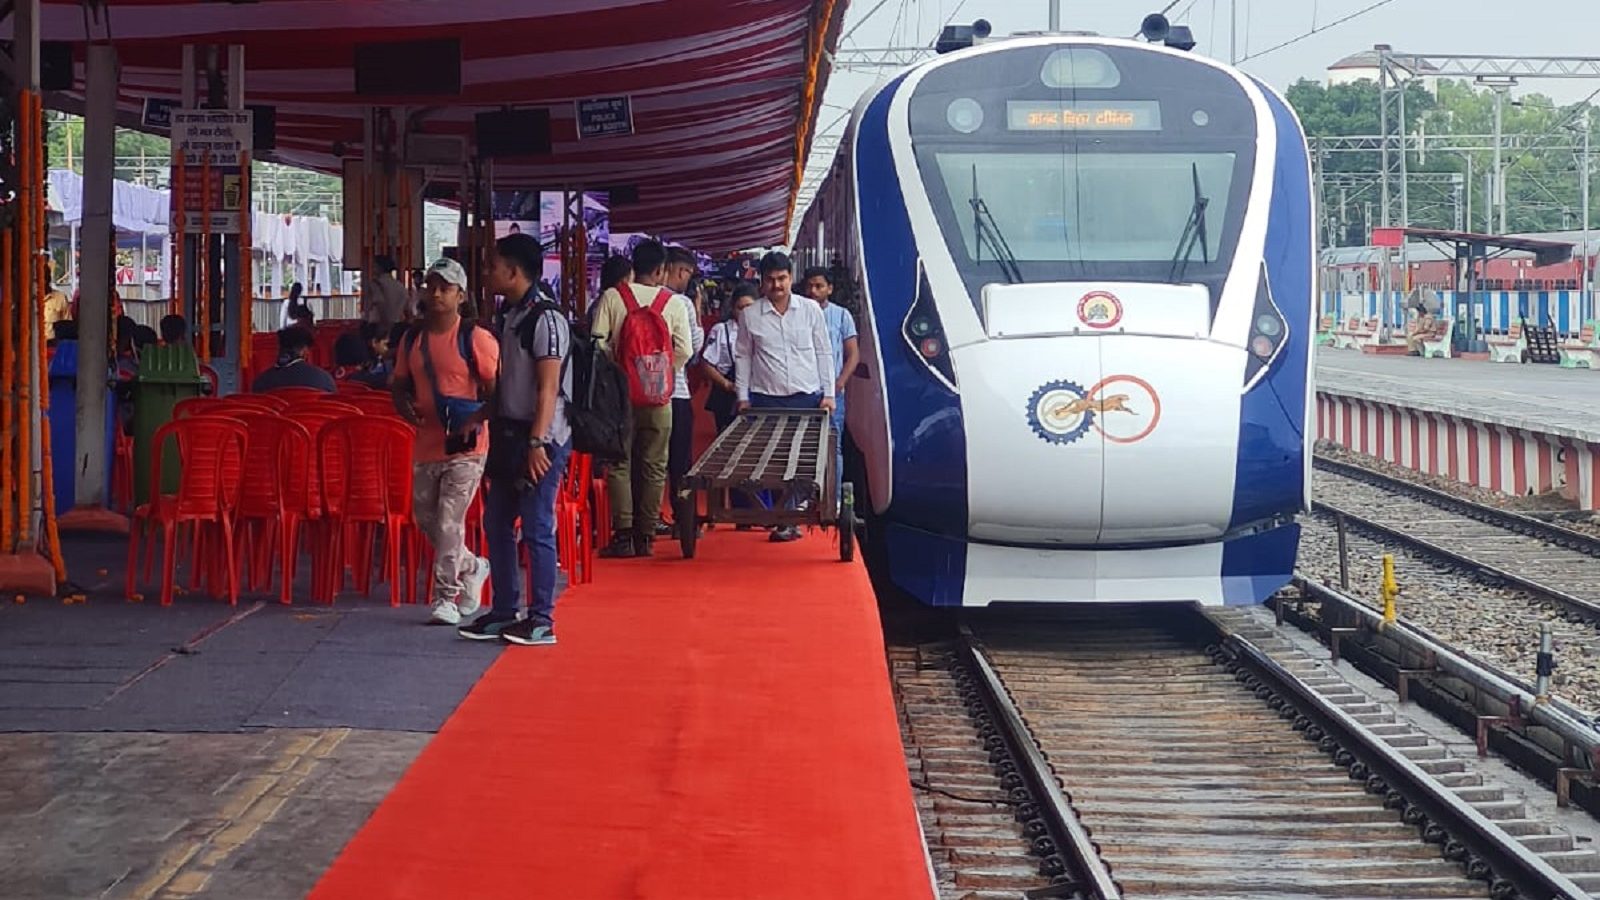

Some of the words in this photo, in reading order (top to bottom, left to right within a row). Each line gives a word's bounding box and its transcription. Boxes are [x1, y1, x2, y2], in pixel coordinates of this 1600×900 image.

[591, 113, 616, 122] POLICE
[583, 124, 600, 132] HELP
[602, 122, 627, 130] BOOTH
